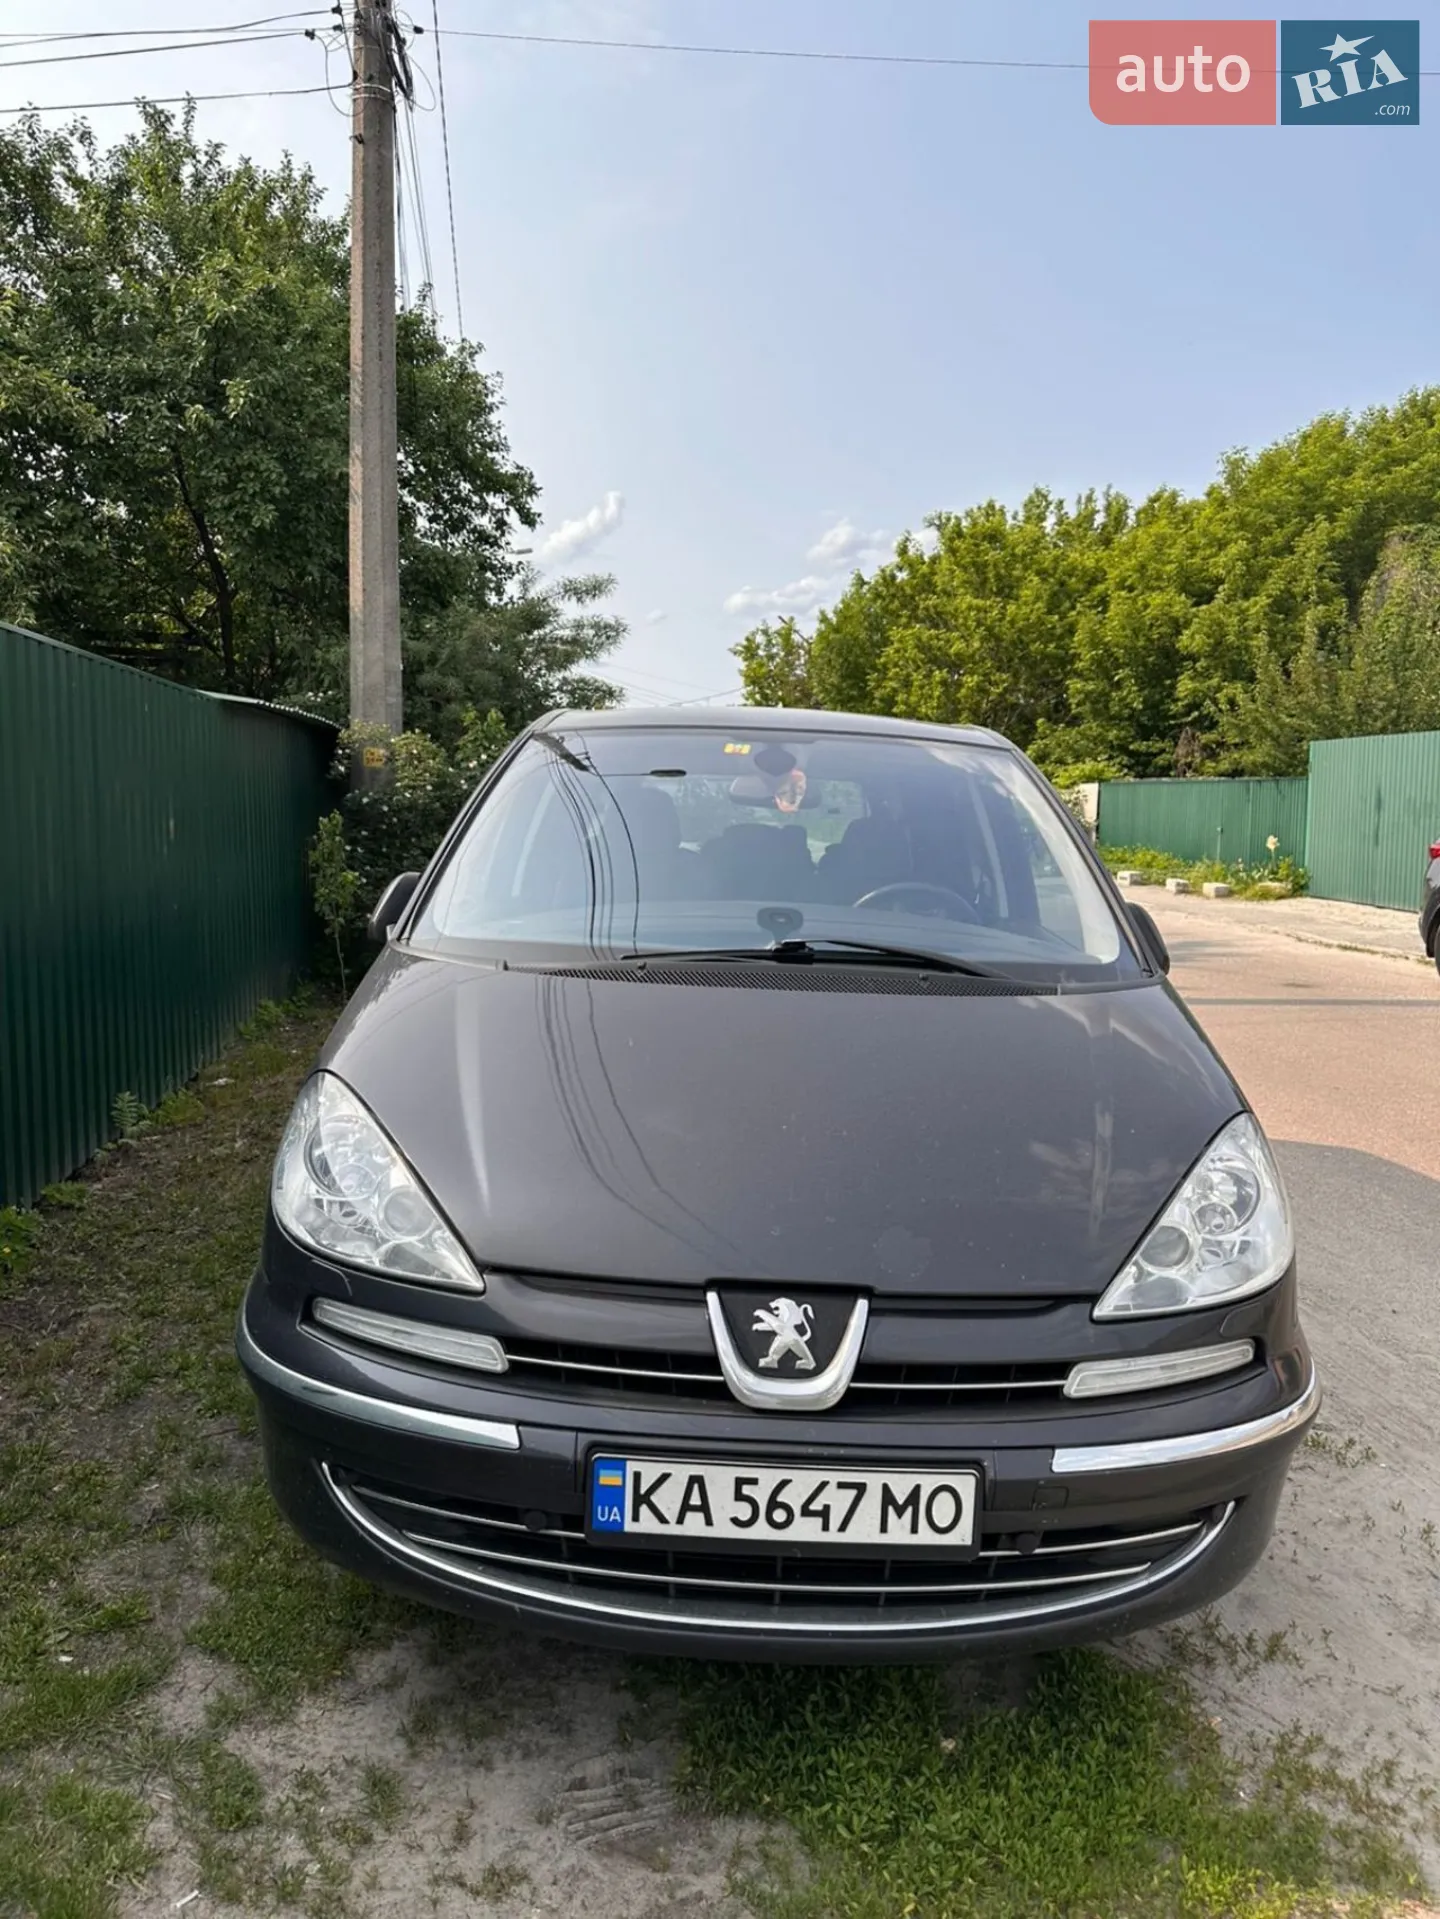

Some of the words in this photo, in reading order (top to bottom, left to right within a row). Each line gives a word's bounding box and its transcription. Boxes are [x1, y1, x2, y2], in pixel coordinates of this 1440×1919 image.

[597, 1505, 621, 1523] UA
[631, 1470, 714, 1527] KA
[729, 1476, 867, 1533] 5647
[879, 1482, 963, 1535] MO
